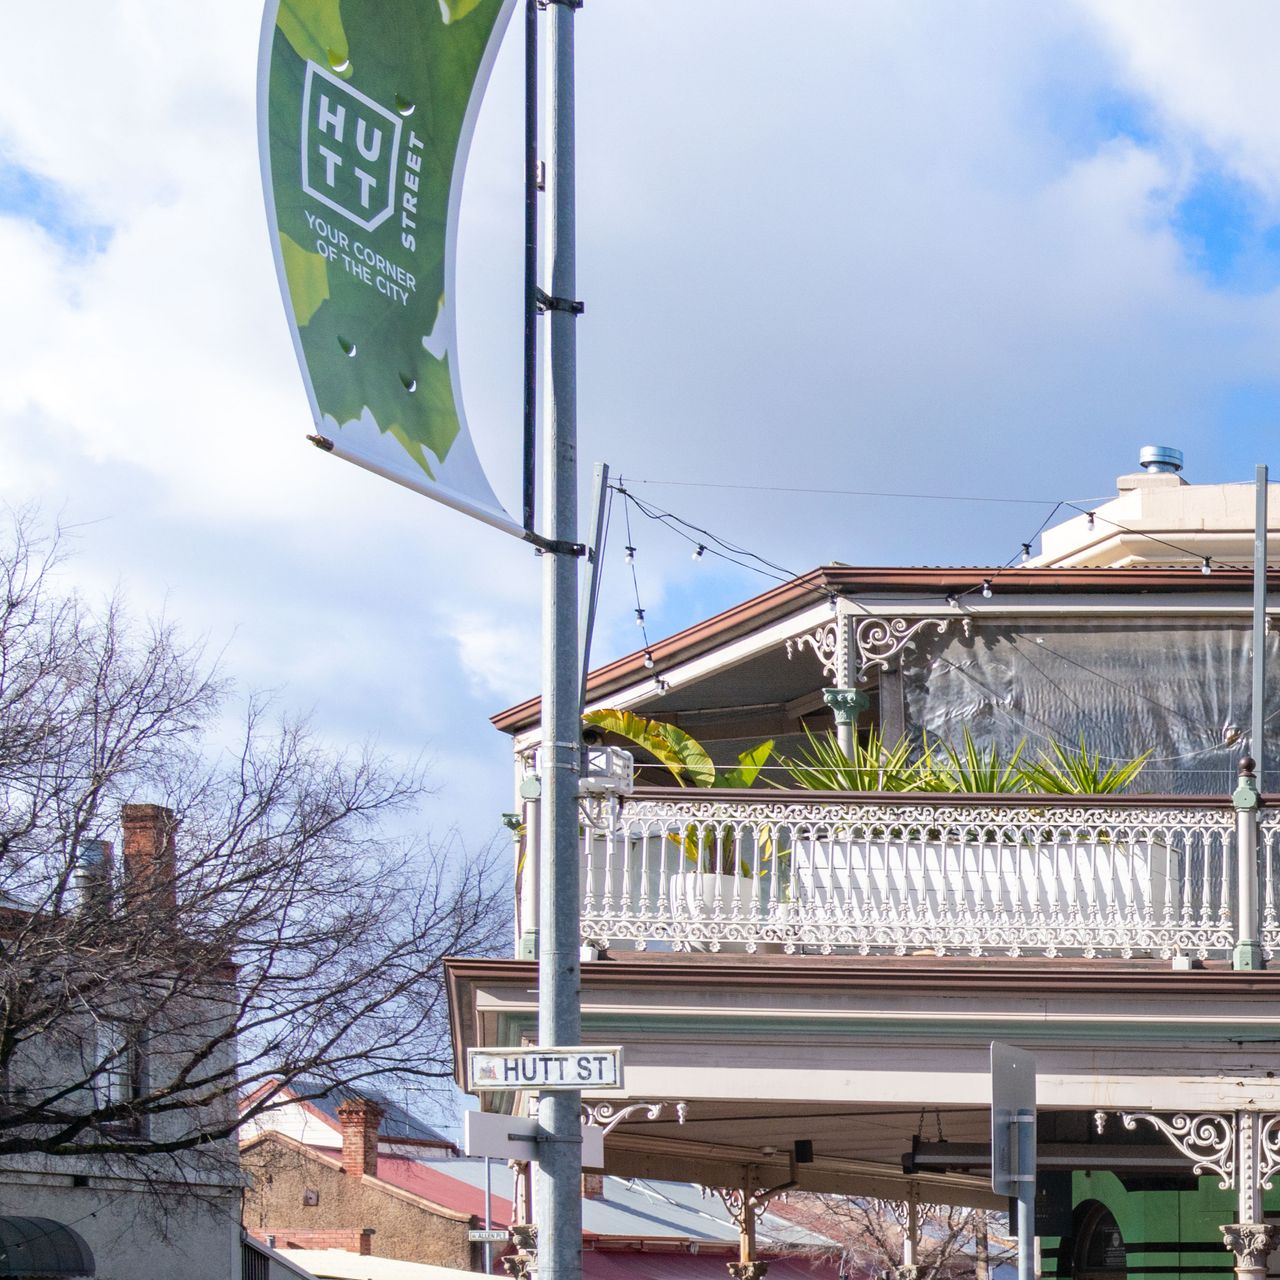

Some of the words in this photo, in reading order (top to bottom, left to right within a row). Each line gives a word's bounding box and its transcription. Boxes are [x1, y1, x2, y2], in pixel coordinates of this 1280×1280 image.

[401, 130, 425, 253] STREET
[304, 209, 350, 252] YOUR
[353, 241, 416, 292] CORNER
[316, 239, 338, 263] OF
[341, 253, 373, 286] THE
[375, 276, 409, 307] CITY
[503, 1057, 569, 1082] HUTT
[577, 1056, 608, 1081] ST
